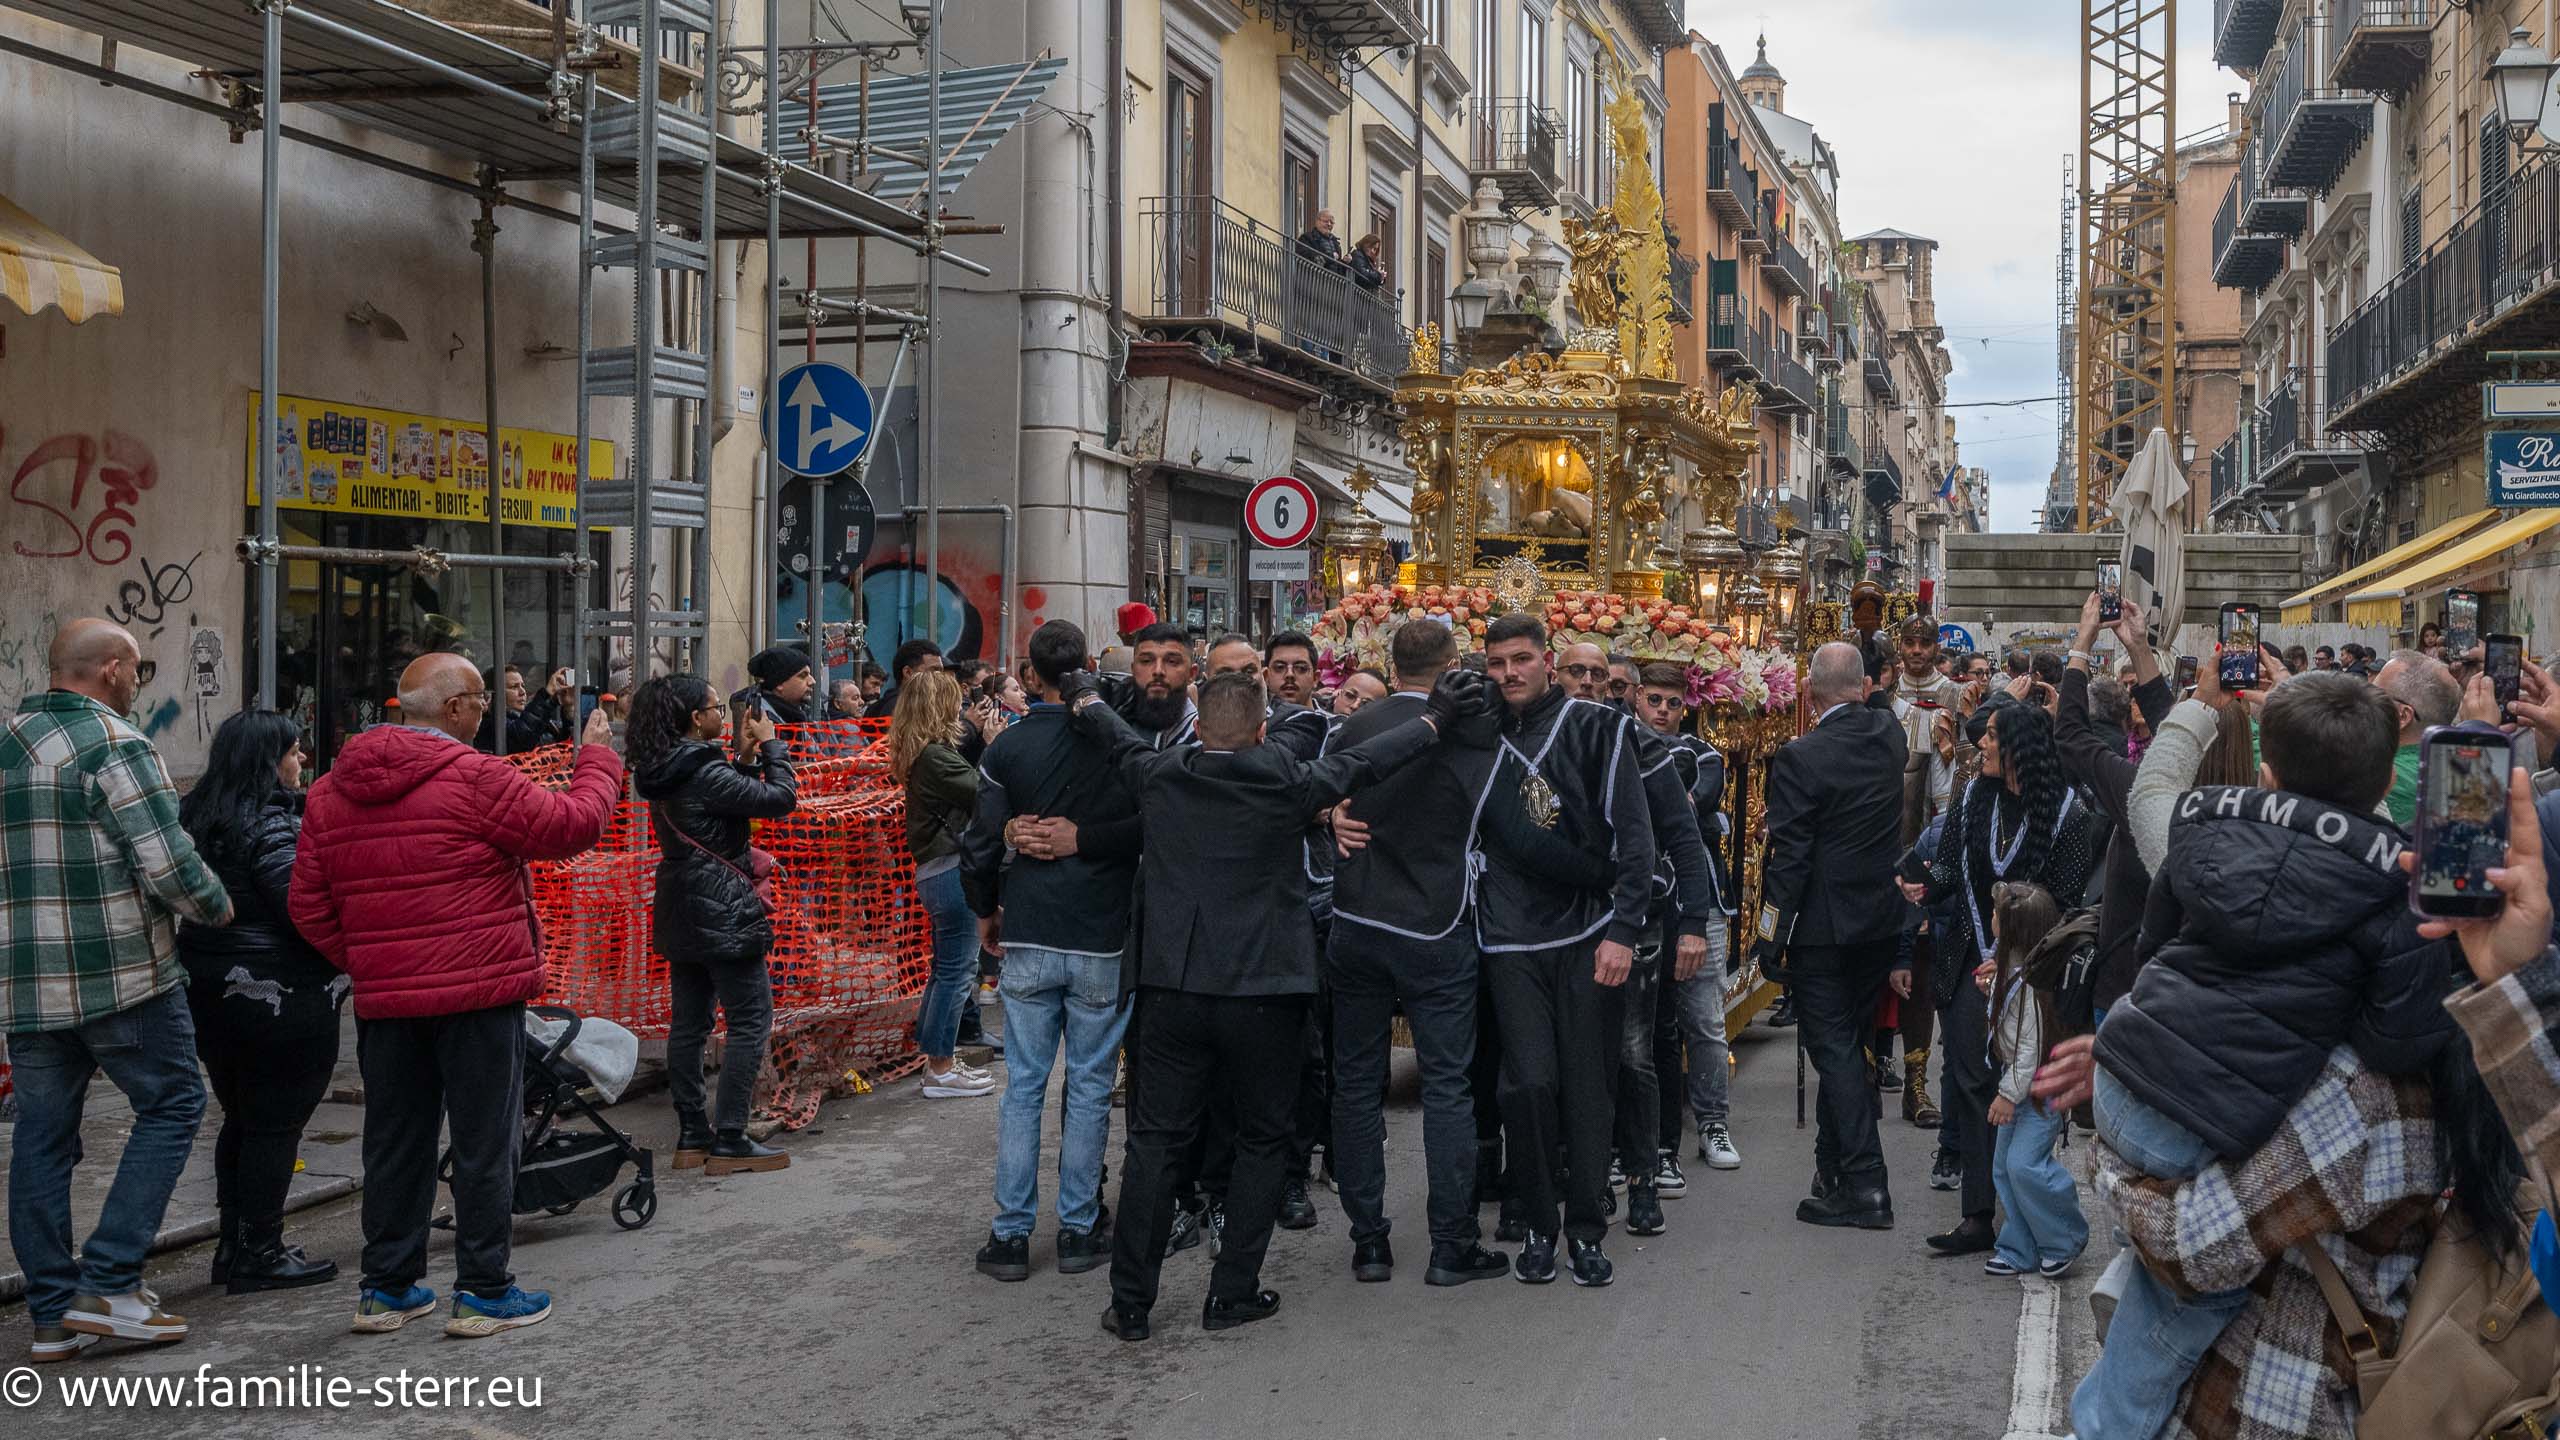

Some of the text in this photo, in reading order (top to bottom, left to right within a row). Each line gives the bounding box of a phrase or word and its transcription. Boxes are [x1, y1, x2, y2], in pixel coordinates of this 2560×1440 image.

[552, 441, 563, 464] IN
[526, 468, 546, 491] PUT
[2510, 476, 2540, 485] SERVIZI
[351, 484, 421, 512] ALIMENTARI
[435, 491, 470, 516] BIBITE
[482, 495, 532, 521] DERSIVI
[2501, 491, 2560, 500] Via Giardinaccio
[541, 505, 566, 523] MINI
[1274, 496, 1289, 528] 6
